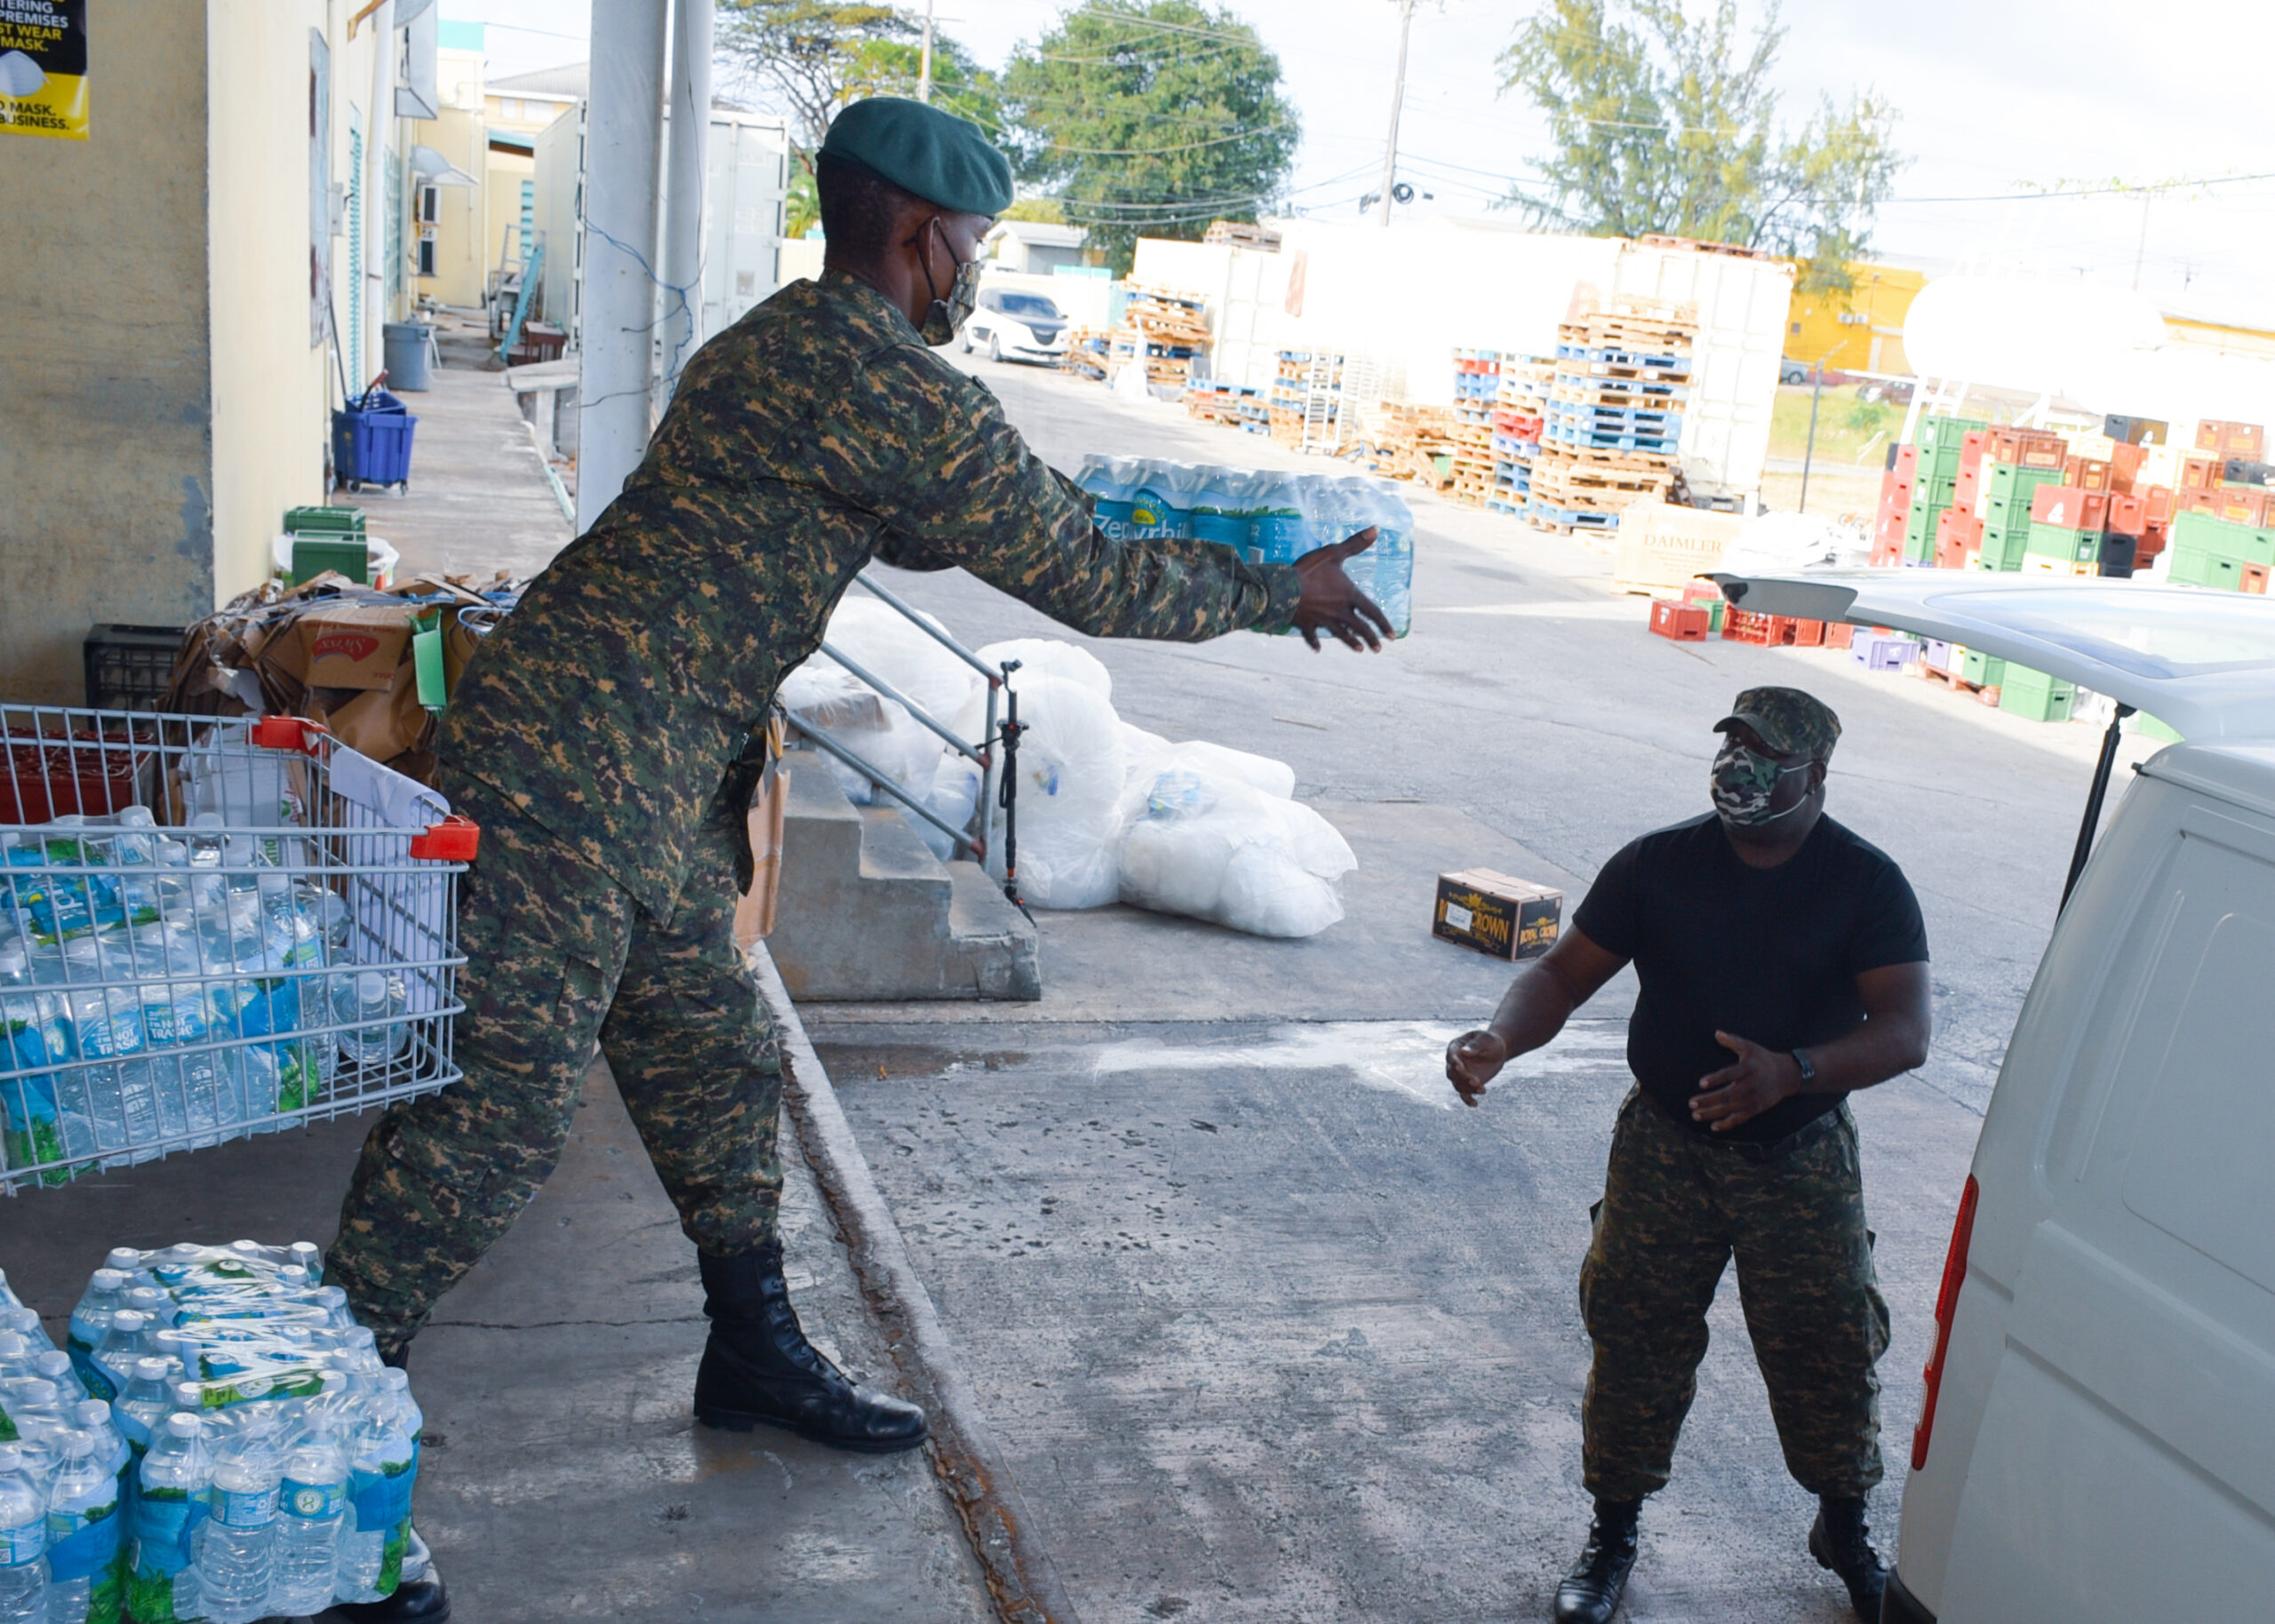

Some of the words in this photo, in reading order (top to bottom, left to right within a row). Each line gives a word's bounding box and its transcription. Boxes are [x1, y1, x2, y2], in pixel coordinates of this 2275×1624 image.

[17, 24, 62, 41] WEAR
[1, 36, 49, 52] MASK.
[10, 101, 56, 117] MASK.
[0, 113, 70, 130] BUSINESS.
[1643, 533, 1721, 553] DAIMLER
[1472, 910, 1510, 944] CROWN
